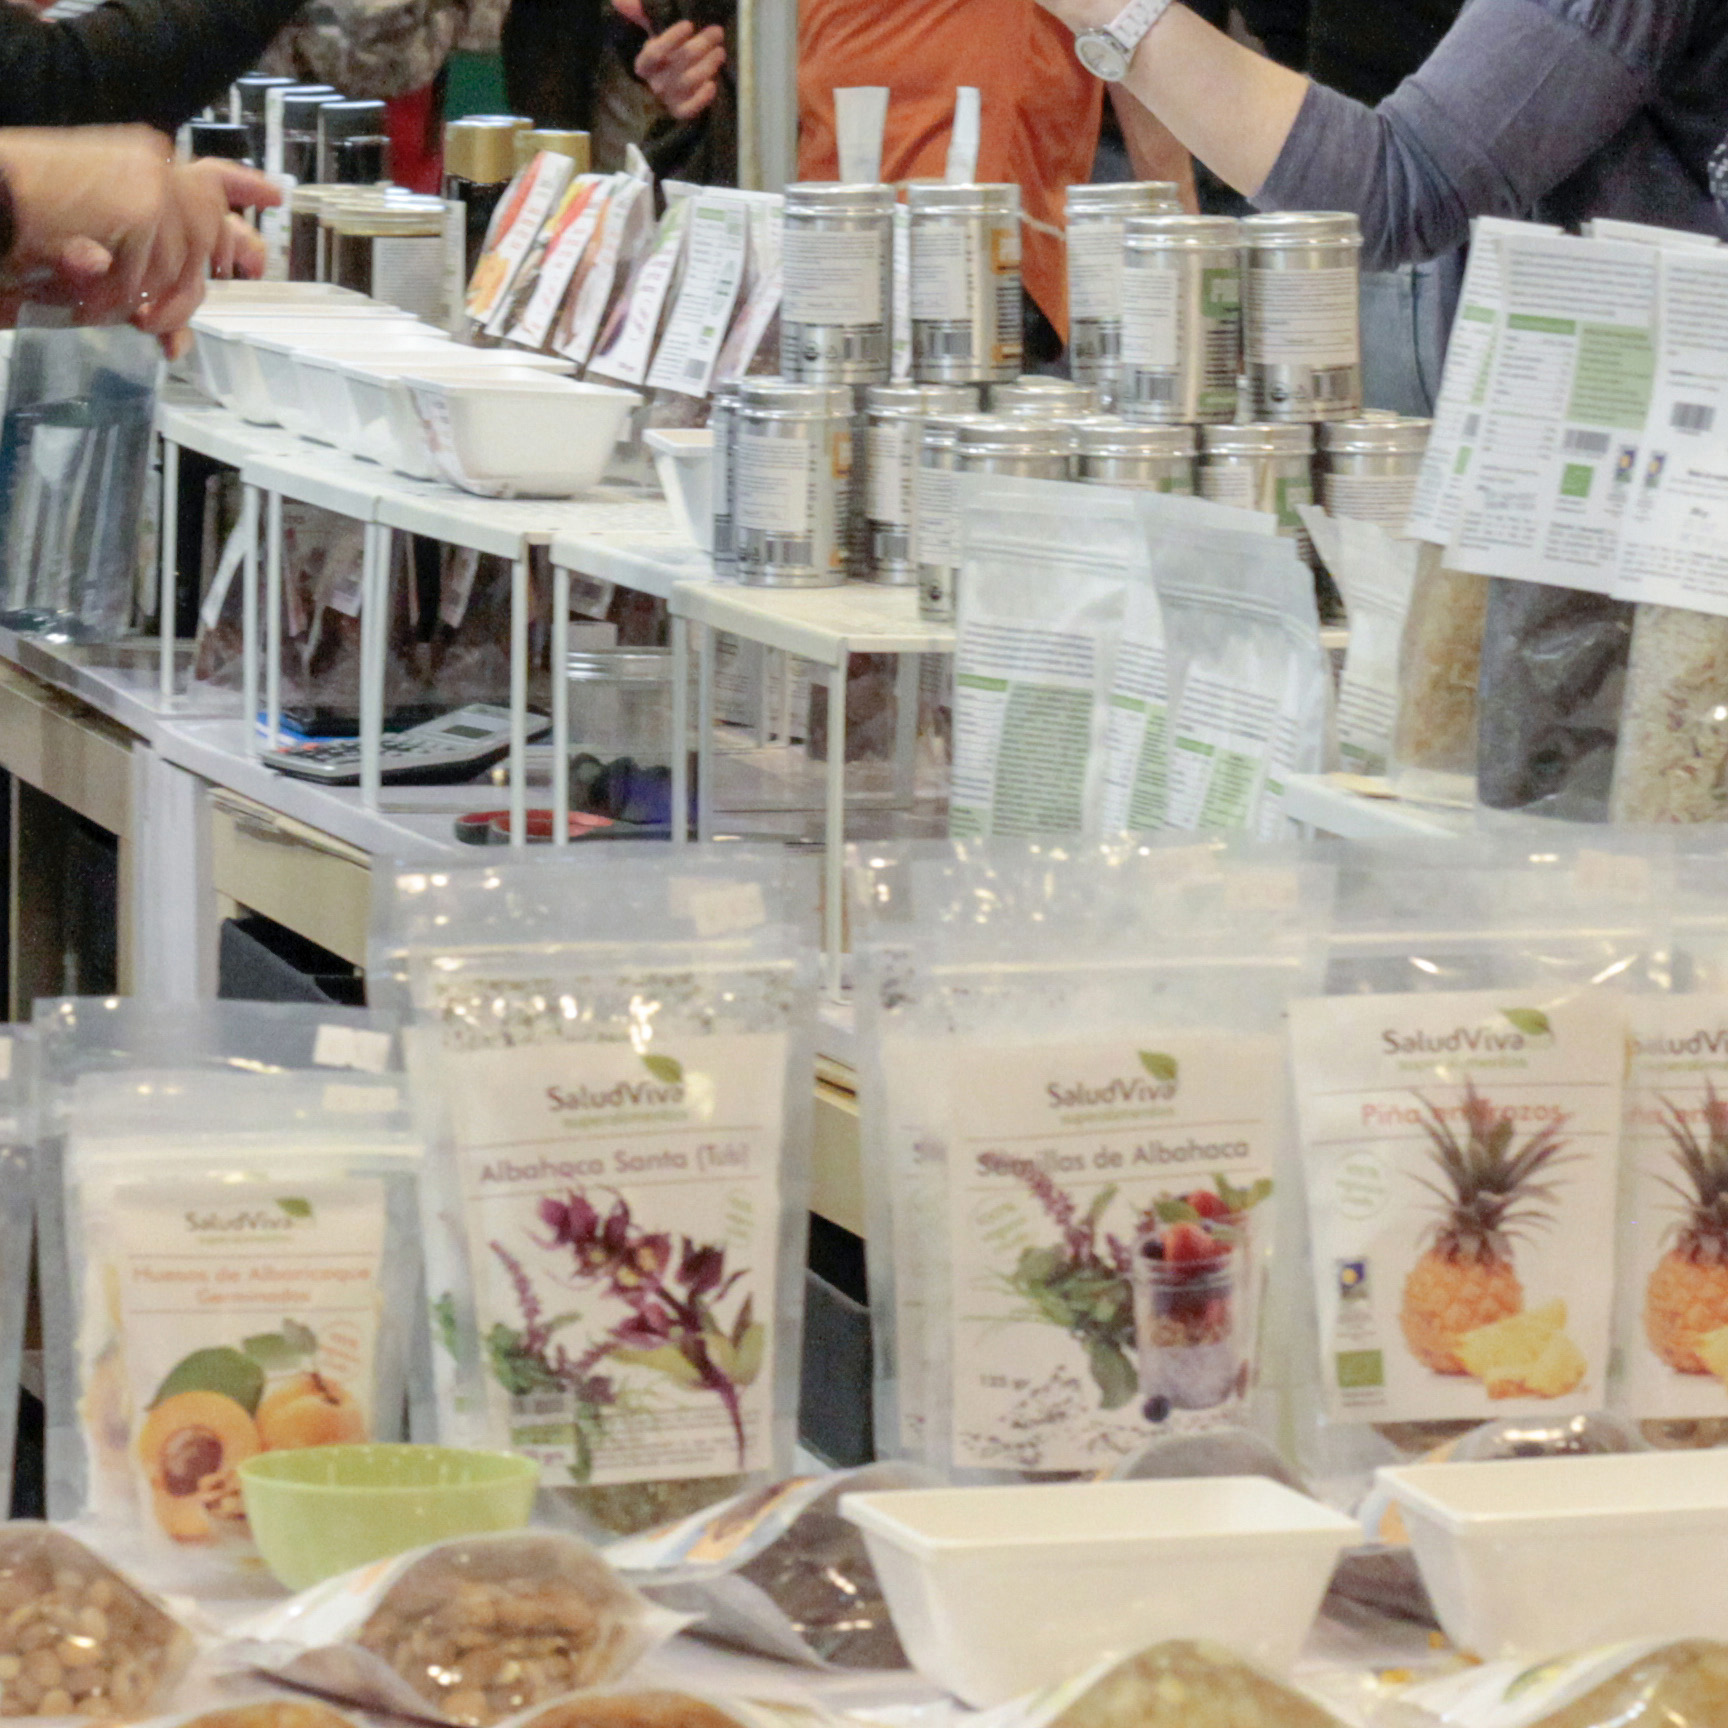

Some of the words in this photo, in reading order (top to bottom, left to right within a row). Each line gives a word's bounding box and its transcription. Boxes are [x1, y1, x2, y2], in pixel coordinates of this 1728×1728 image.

[1382, 1026, 1525, 1055] SaludViva
[545, 1080, 685, 1112] SaludViva
[1046, 1078, 1178, 1108] SaludViva
[1361, 1103, 1421, 1125] Piña
[480, 1156, 605, 1184] Albahaca
[613, 1149, 688, 1173] Santa
[1092, 1144, 1123, 1169] de
[1132, 1138, 1250, 1164] Albahaca
